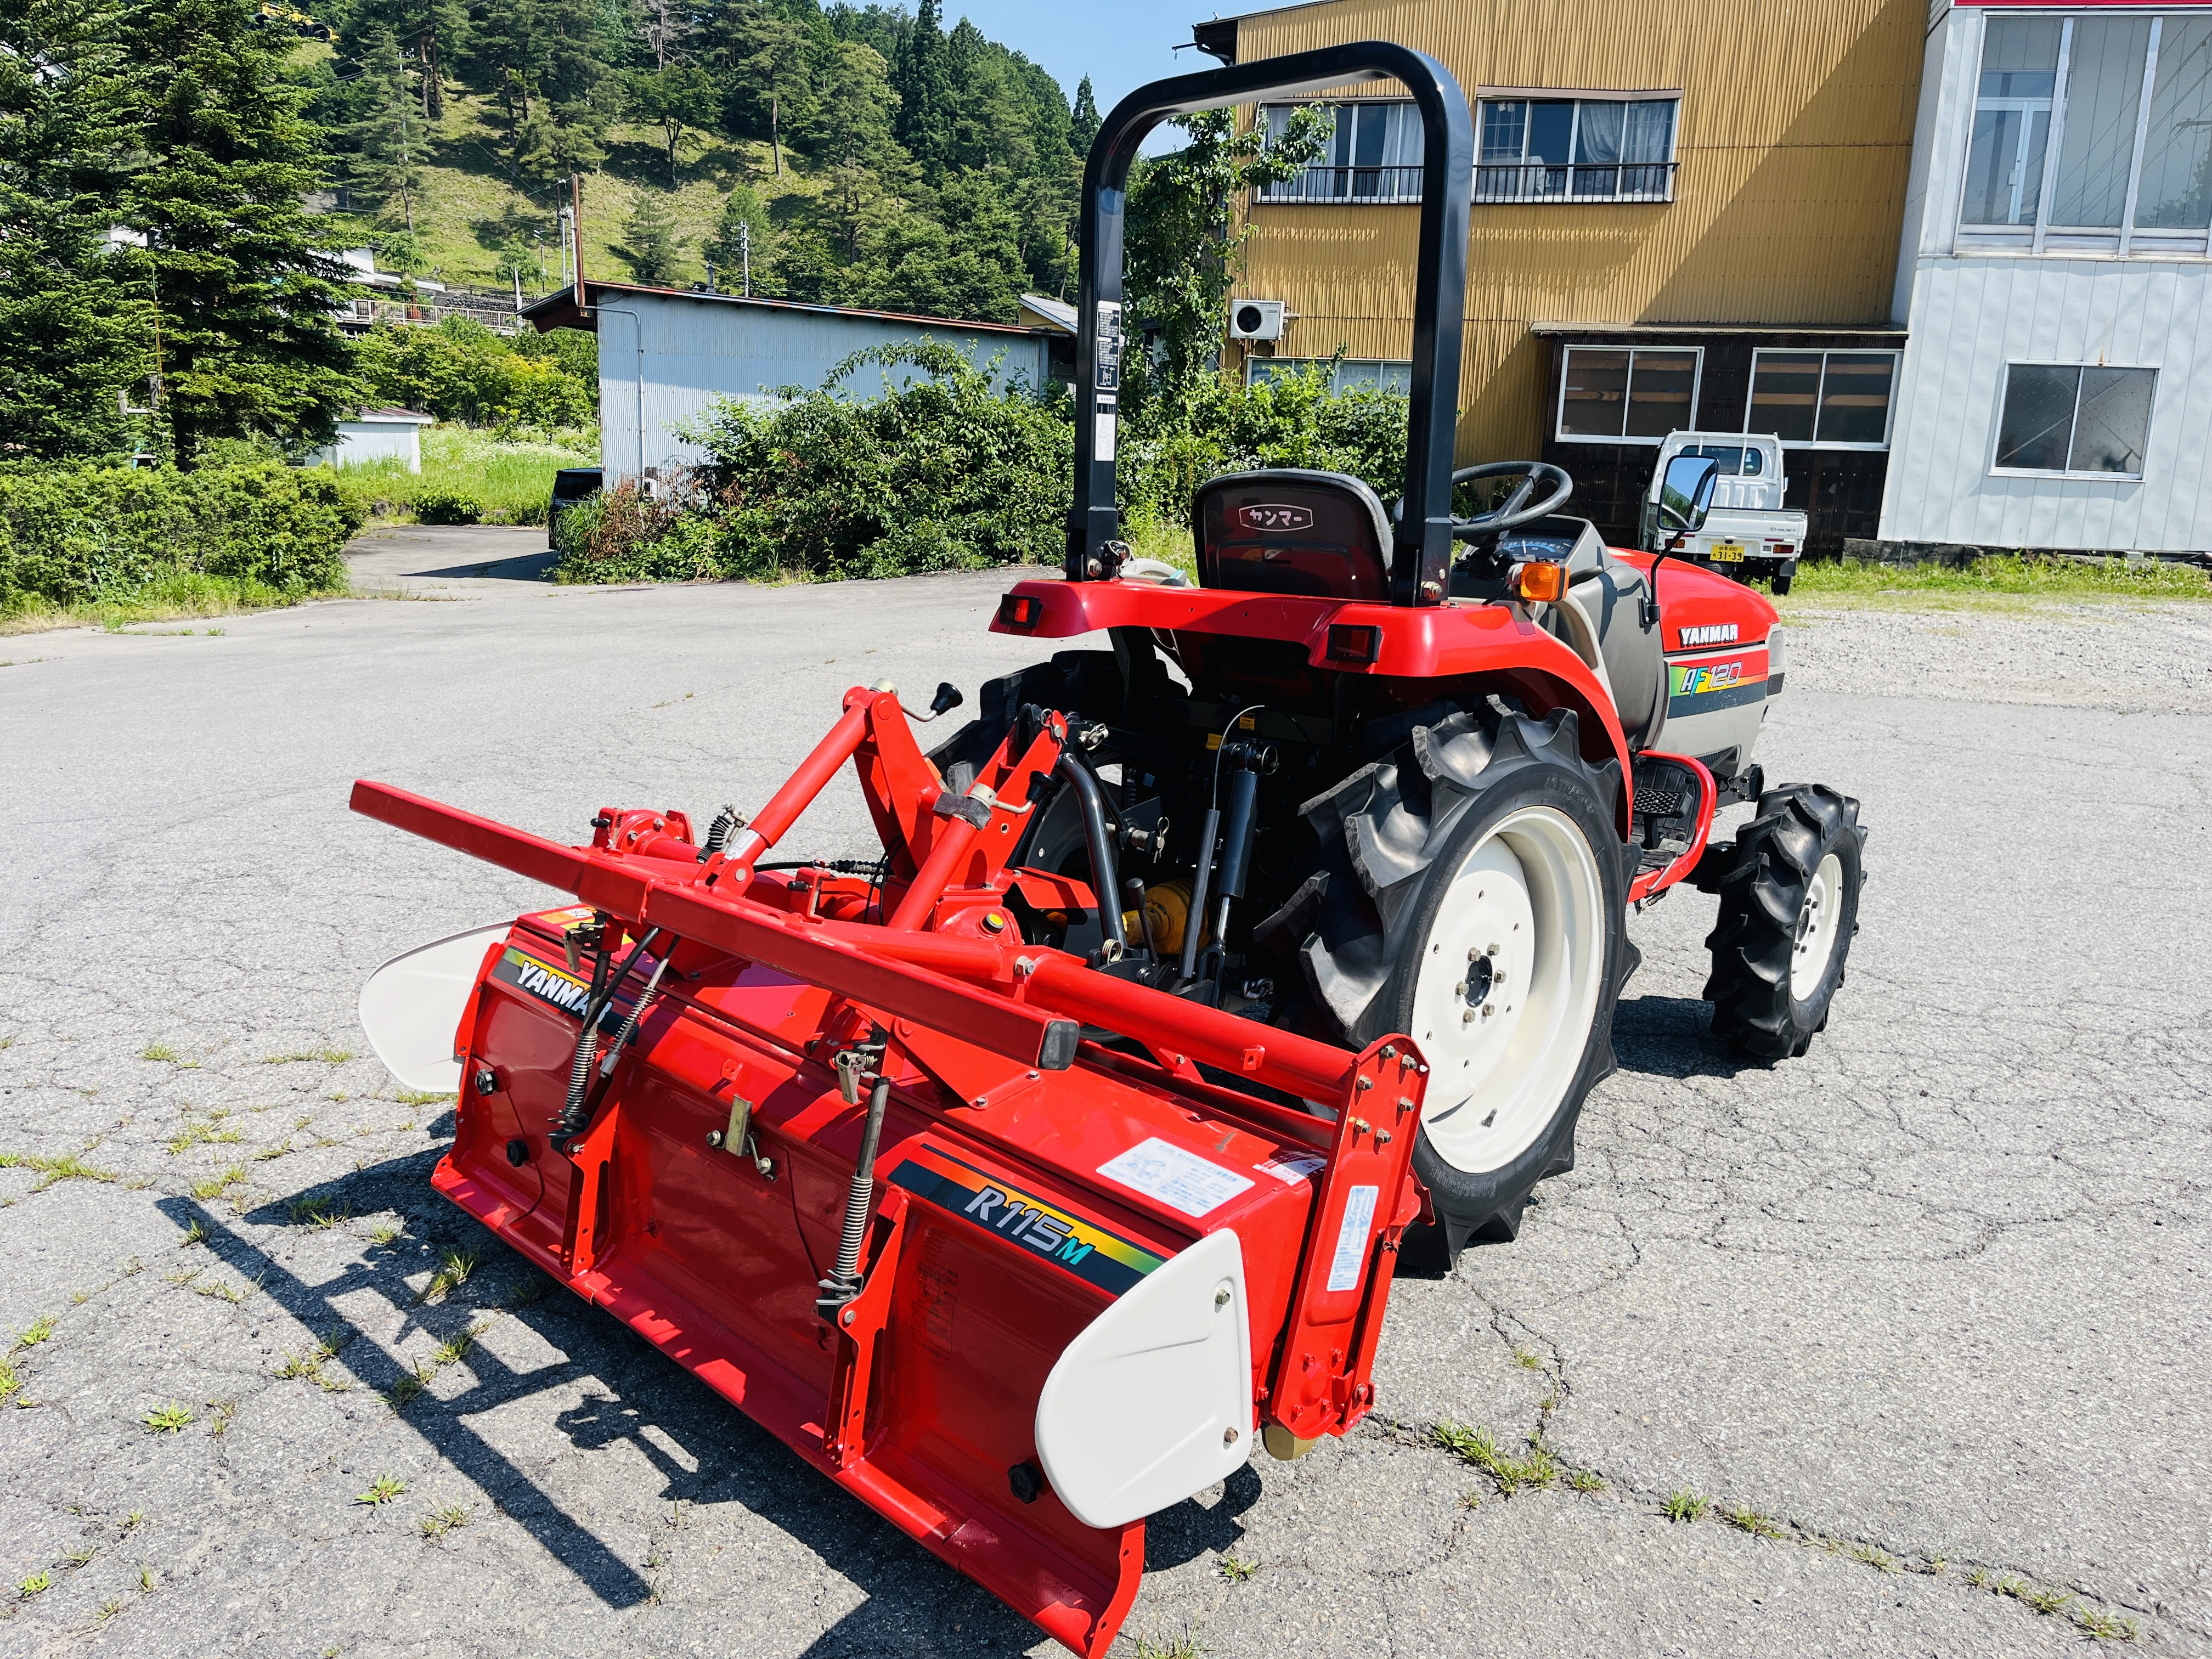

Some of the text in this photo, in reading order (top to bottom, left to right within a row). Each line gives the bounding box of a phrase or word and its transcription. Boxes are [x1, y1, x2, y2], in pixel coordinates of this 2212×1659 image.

[1717, 551, 1742, 561] 31-39
[1679, 624, 1739, 647] YANMAR
[1680, 661, 1742, 697] AF120
[964, 1184, 1096, 1266] R115M
